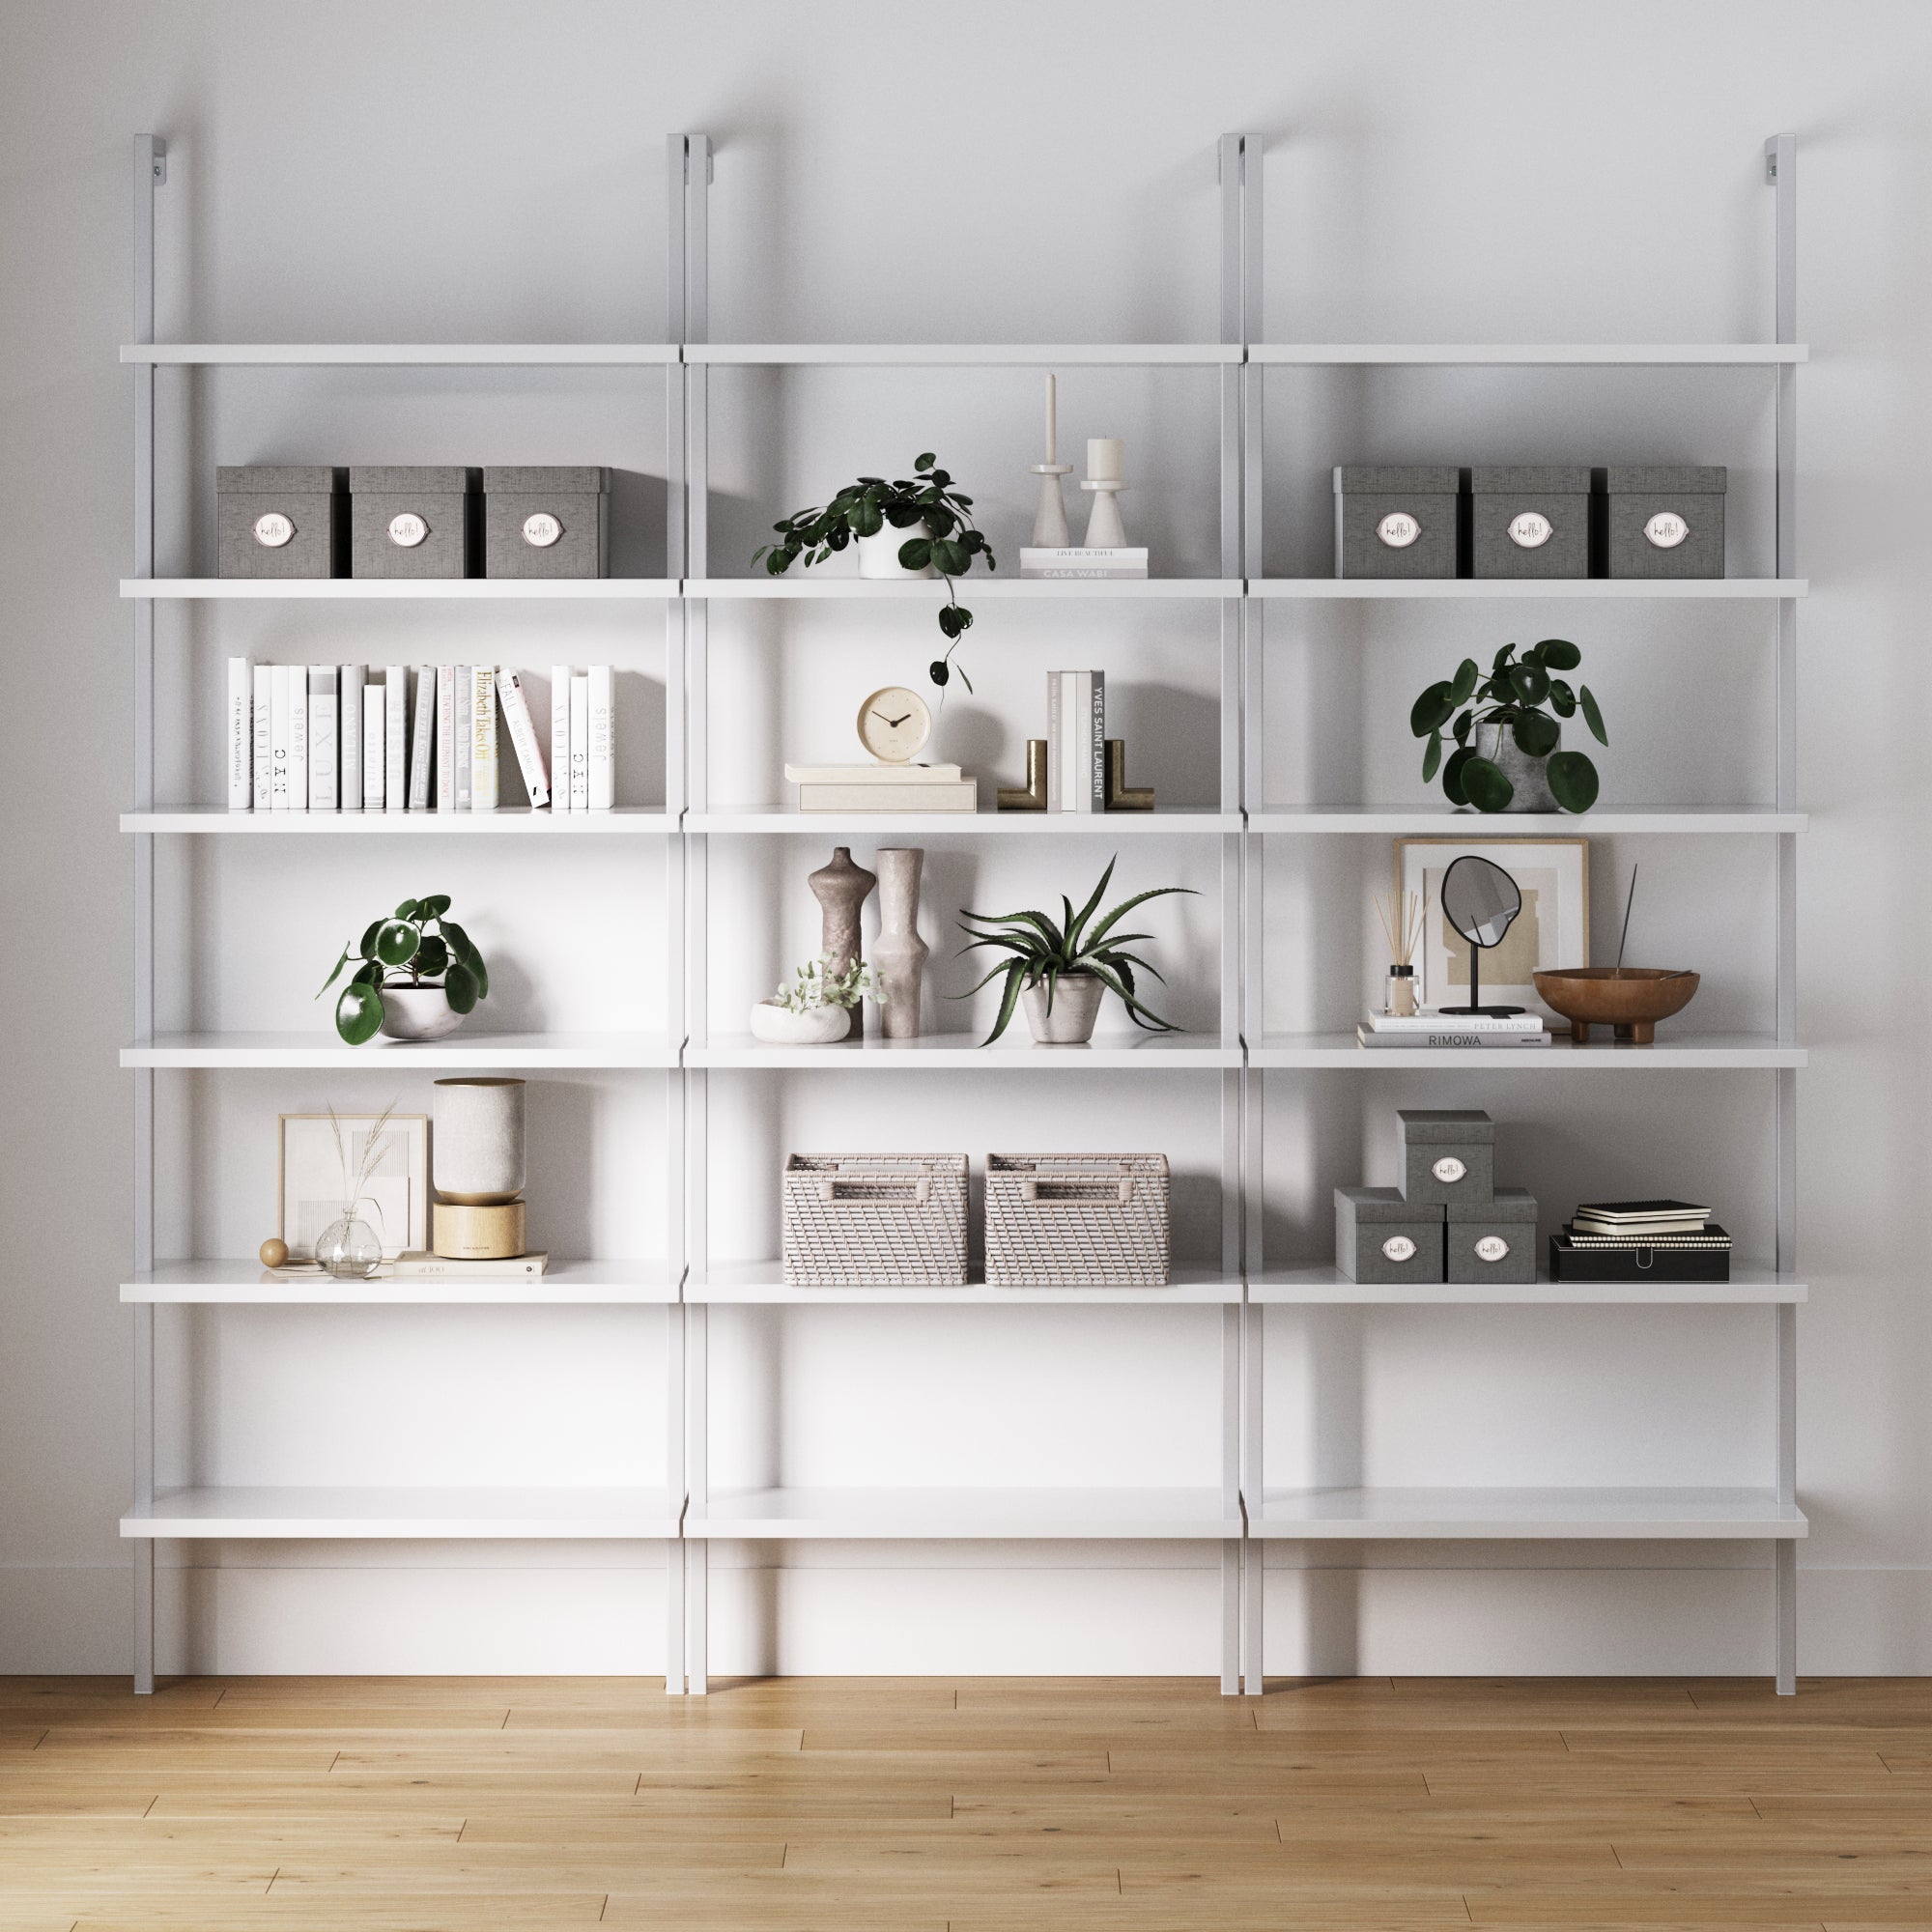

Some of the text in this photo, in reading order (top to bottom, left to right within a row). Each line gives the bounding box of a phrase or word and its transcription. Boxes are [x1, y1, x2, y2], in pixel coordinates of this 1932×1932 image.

[260, 522, 285, 536] hello!
[394, 522, 418, 536] hello!
[528, 522, 553, 536] hello!
[1385, 522, 1411, 537] hello!
[1517, 522, 1543, 537] hello!
[1653, 522, 1679, 537] hello!
[1043, 569, 1108, 579] CASA WABI
[477, 671, 492, 716] Elizabeth
[500, 683, 518, 712] FALL
[292, 707, 304, 761] Jewels
[345, 703, 356, 770] MILANO
[476, 717, 491, 743] Takes
[593, 707, 607, 761] Jewels
[315, 703, 332, 803] LUXE
[1094, 687, 1103, 800] YVES SAINT LAURENT
[274, 749, 286, 794] NYC
[573, 753, 584, 794] NYC
[1473, 1022, 1504, 1031] PETER
[1506, 1022, 1537, 1031] LYNCH
[1428, 1035, 1482, 1046] RIMOWA
